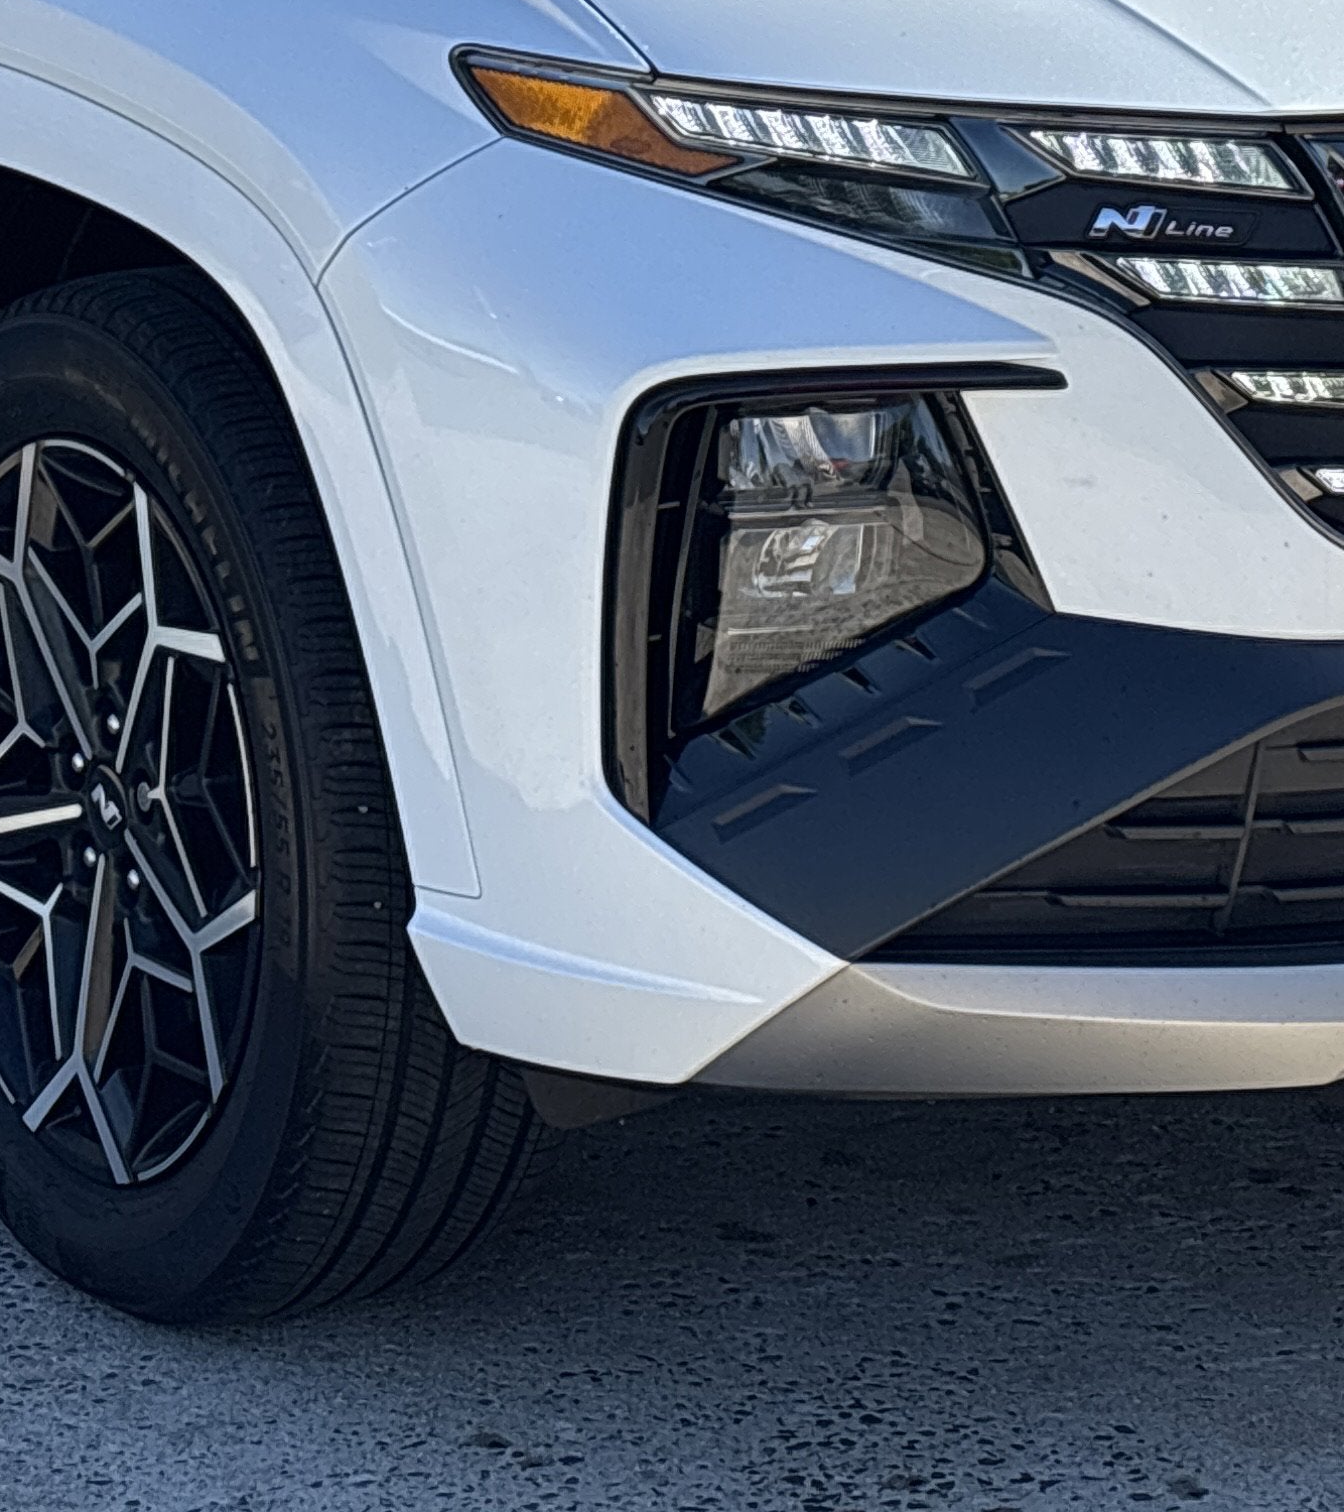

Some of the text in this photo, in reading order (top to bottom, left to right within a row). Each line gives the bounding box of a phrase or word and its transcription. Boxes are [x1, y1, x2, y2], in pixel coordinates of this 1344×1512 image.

[1089, 205, 1234, 239] N Line
[261, 720, 292, 857] 235/55
